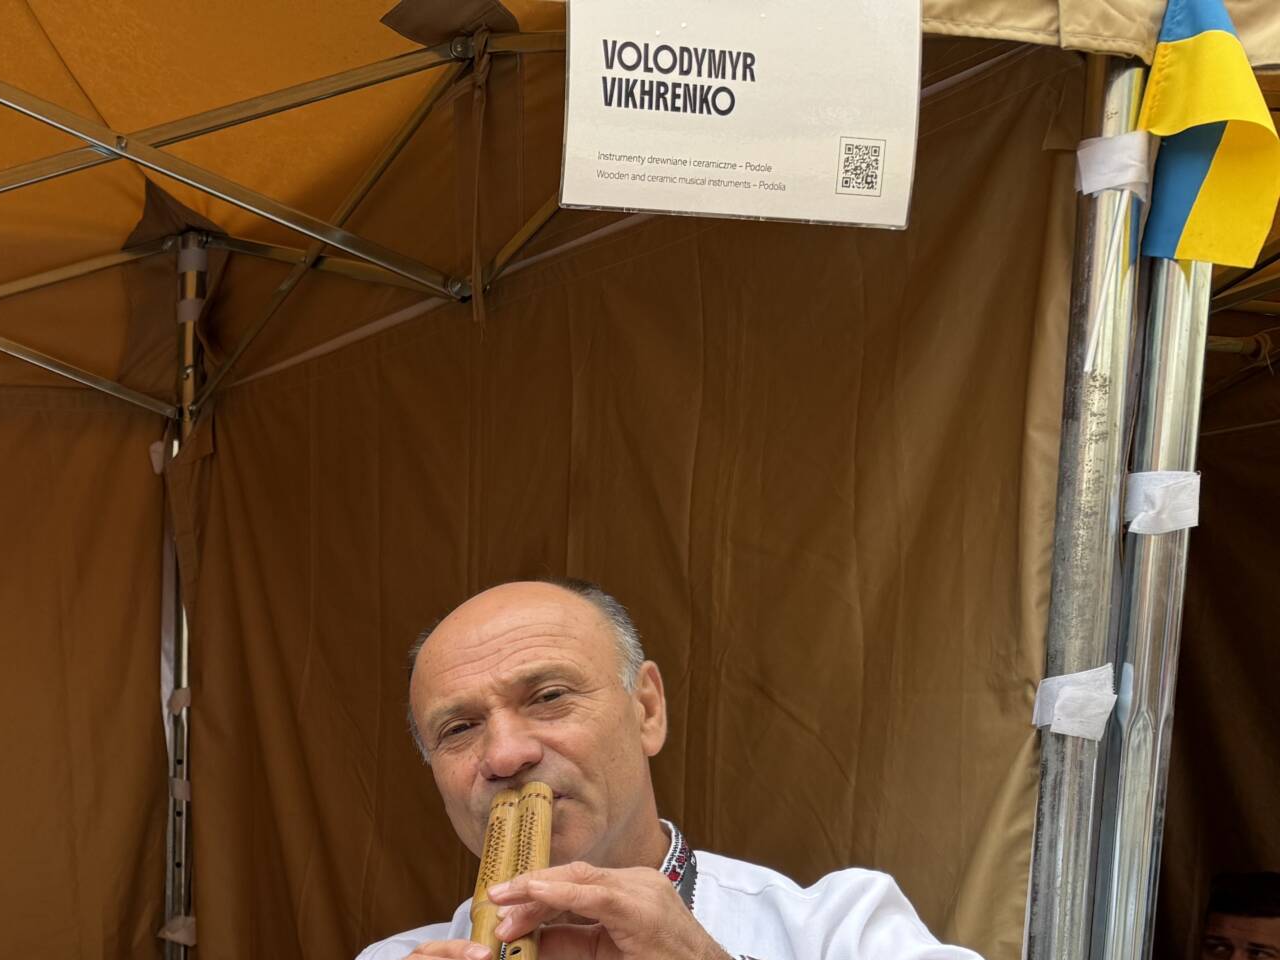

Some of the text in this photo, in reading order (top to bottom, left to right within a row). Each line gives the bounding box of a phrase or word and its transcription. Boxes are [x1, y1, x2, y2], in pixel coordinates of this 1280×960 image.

[602, 39, 756, 82] VOLODYMYR
[602, 76, 735, 116] VIKHRENKO
[597, 151, 645, 165] Instrumenty
[647, 155, 688, 167] drewniane
[693, 159, 737, 170] ceramiczne
[745, 162, 772, 172] Podole
[596, 169, 629, 180] Wooden
[631, 172, 646, 181] and
[647, 174, 677, 184] ceramic
[678, 175, 706, 186] musical
[707, 178, 751, 189] instruments
[758, 180, 786, 191] Podolia
